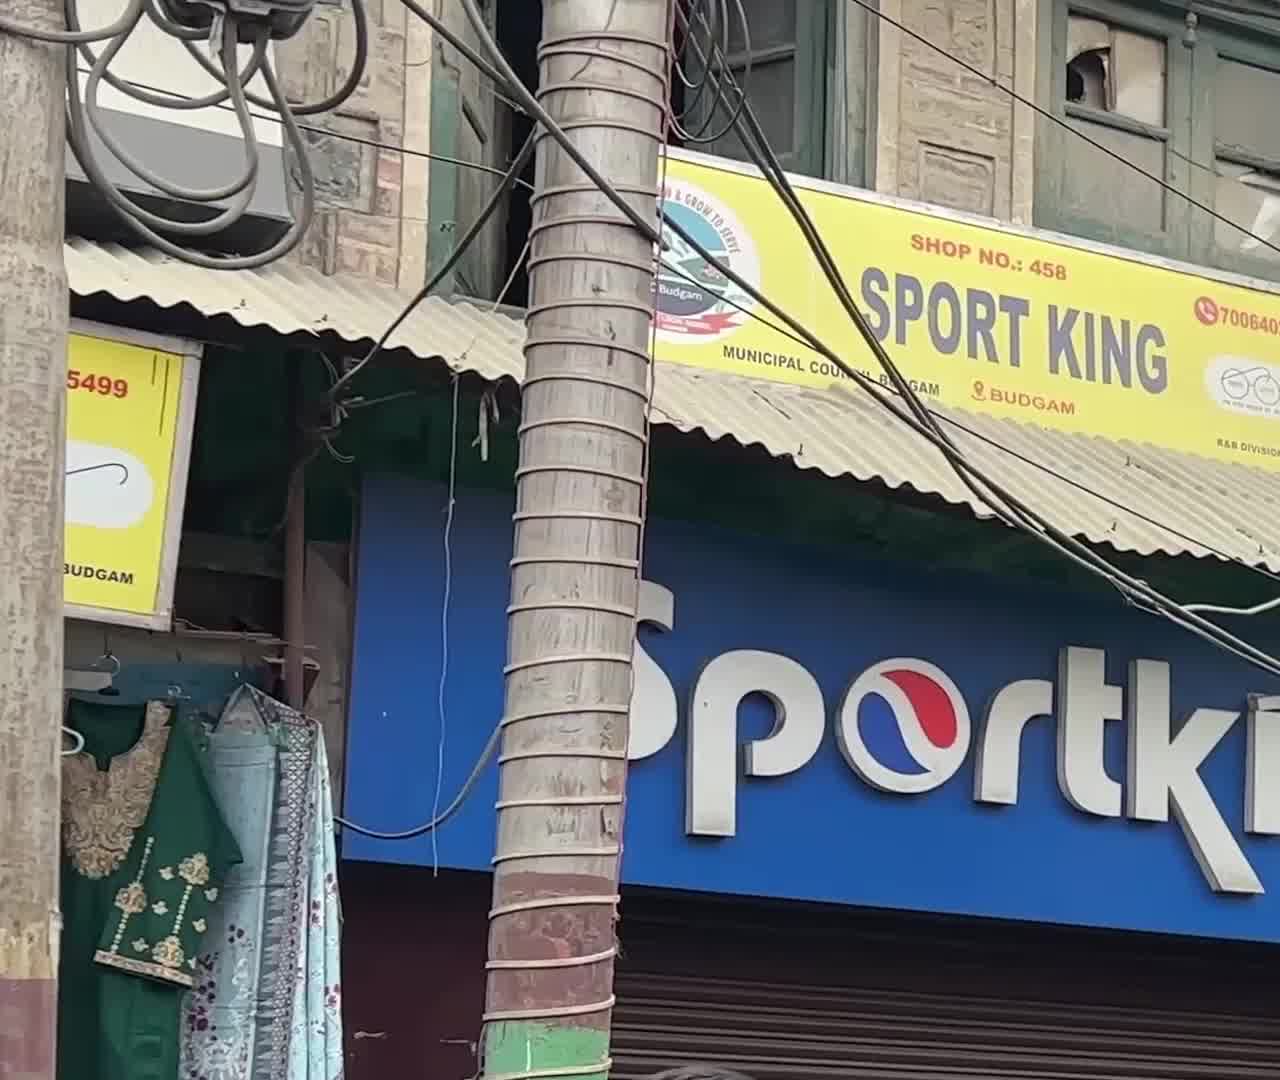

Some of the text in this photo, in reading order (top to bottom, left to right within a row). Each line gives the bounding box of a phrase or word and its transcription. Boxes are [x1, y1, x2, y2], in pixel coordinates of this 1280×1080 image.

[911, 234, 1067, 280] SHOP NO.: 458
[659, 284, 703, 301] Budgam
[861, 266, 1168, 395] SPORT KING
[67, 369, 129, 399] 5499
[723, 345, 940, 396] MUNICIPAL BGAM
[990, 387, 1075, 415] BUDGAM
[1216, 438, 1238, 450] R&B
